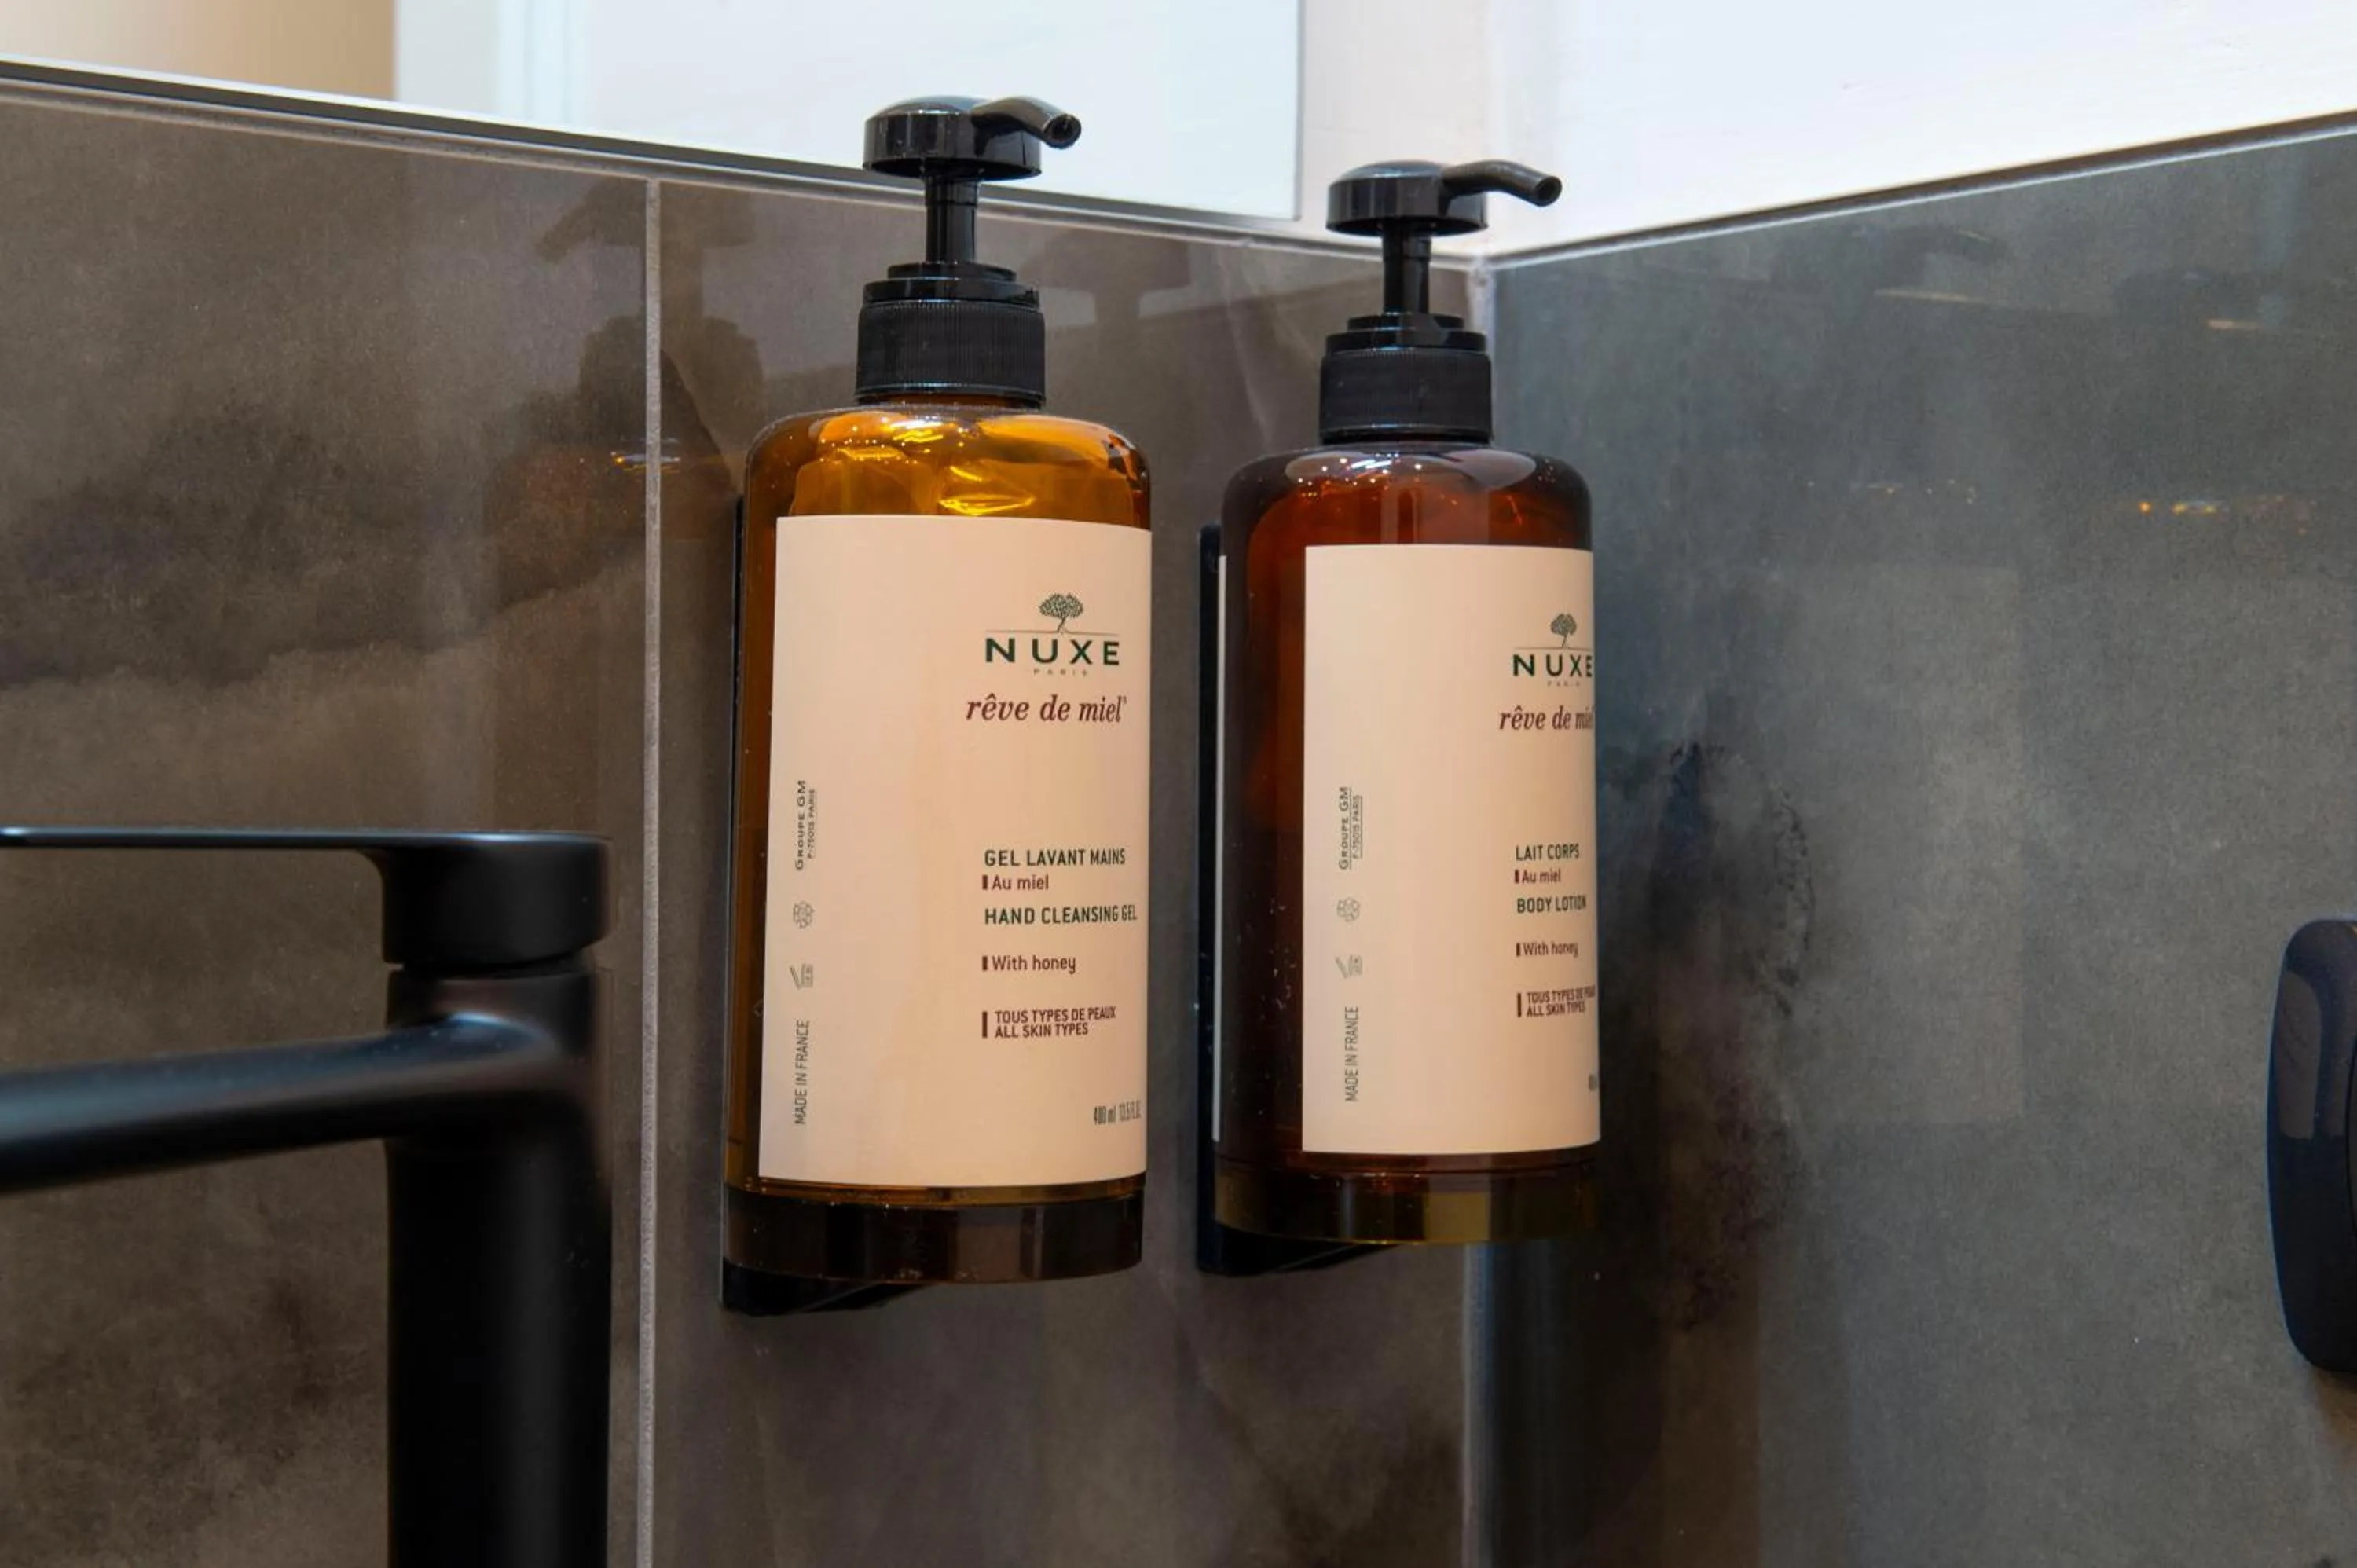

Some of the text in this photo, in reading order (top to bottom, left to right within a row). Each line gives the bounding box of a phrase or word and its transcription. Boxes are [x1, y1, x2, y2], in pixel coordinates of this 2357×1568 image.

[985, 638, 1120, 665] NUXE
[1512, 654, 1593, 677] NUXE
[966, 692, 1029, 721] rêve
[1039, 694, 1071, 721] de
[1499, 705, 1546, 730] rêve
[1552, 705, 1571, 730] de
[795, 780, 805, 870] GROUPE GM
[1339, 786, 1349, 870] GROUPE GM
[984, 848, 1126, 866] GEL LAVANT MAINS
[1516, 843, 1579, 861] LAIT CORPS
[992, 874, 1049, 890] Au miel
[1522, 868, 1561, 883] Au miel
[1517, 894, 1587, 913] BODY LOTION
[984, 904, 1137, 925] HAND CLEANSING GEL
[1523, 942, 1578, 958] With honey
[992, 955, 1076, 975] With honey
[995, 1006, 1116, 1024] TOUS TYPES DE PEAUX
[1527, 1005, 1545, 1017] ALL
[995, 1022, 1088, 1039] ALL SKIN TYPES
[1344, 1006, 1358, 1101] MADE IN FRANCE
[794, 1020, 809, 1125] MADE IN FRANCE
